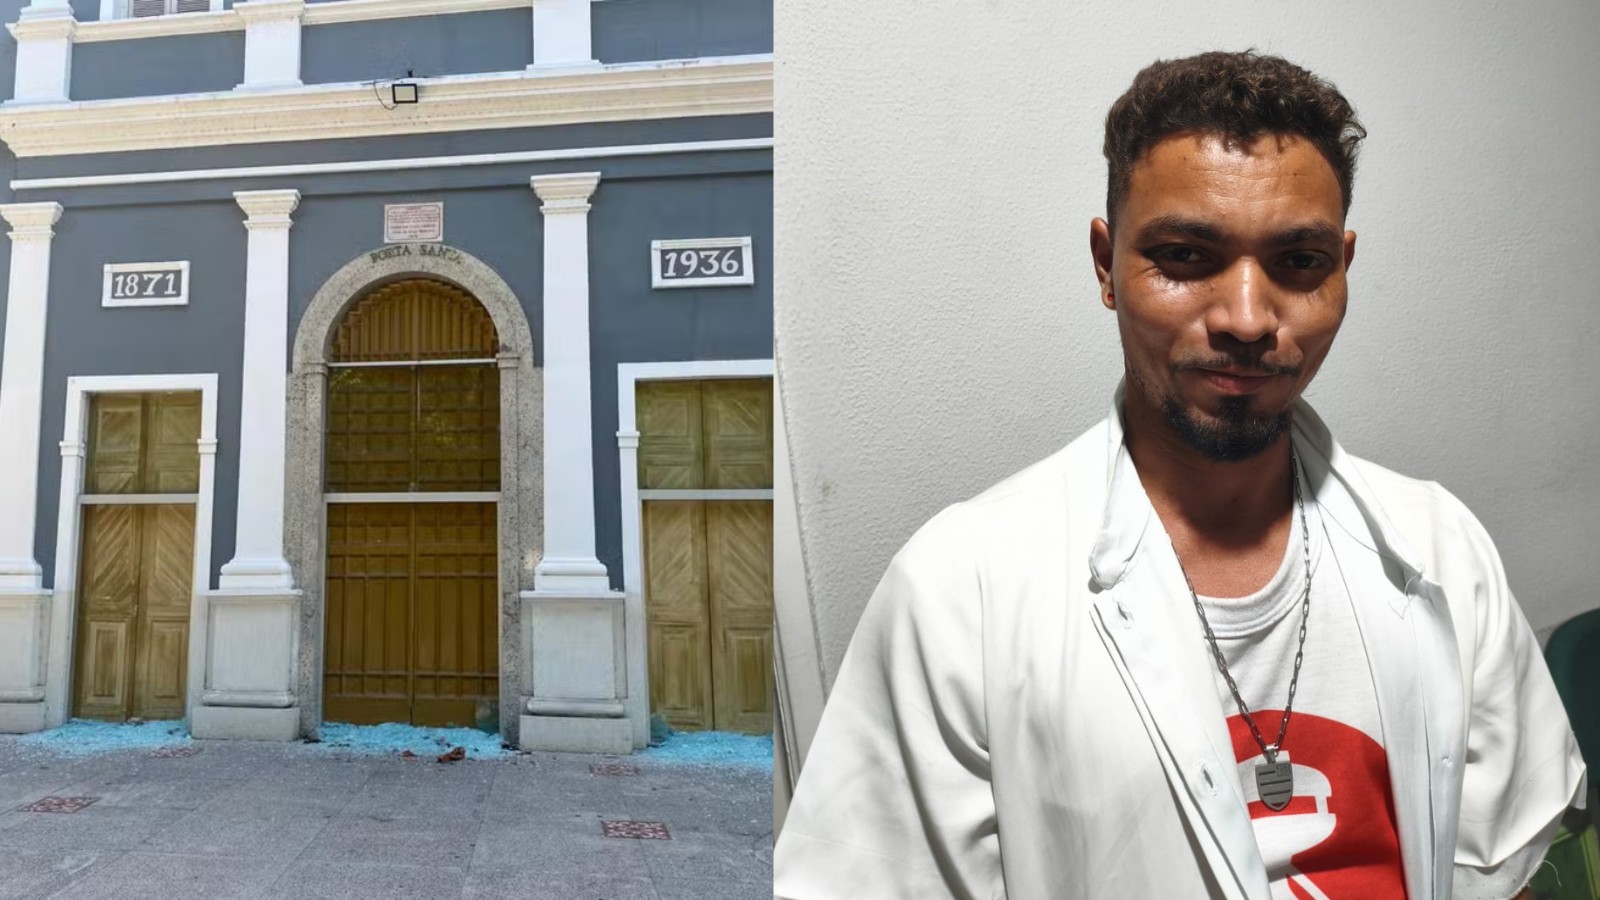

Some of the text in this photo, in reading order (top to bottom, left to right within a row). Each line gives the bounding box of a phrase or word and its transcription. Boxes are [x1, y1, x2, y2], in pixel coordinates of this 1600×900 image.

[370, 245, 412, 263] PORTA
[663, 249, 739, 277] 1936
[114, 273, 177, 297] 1871
